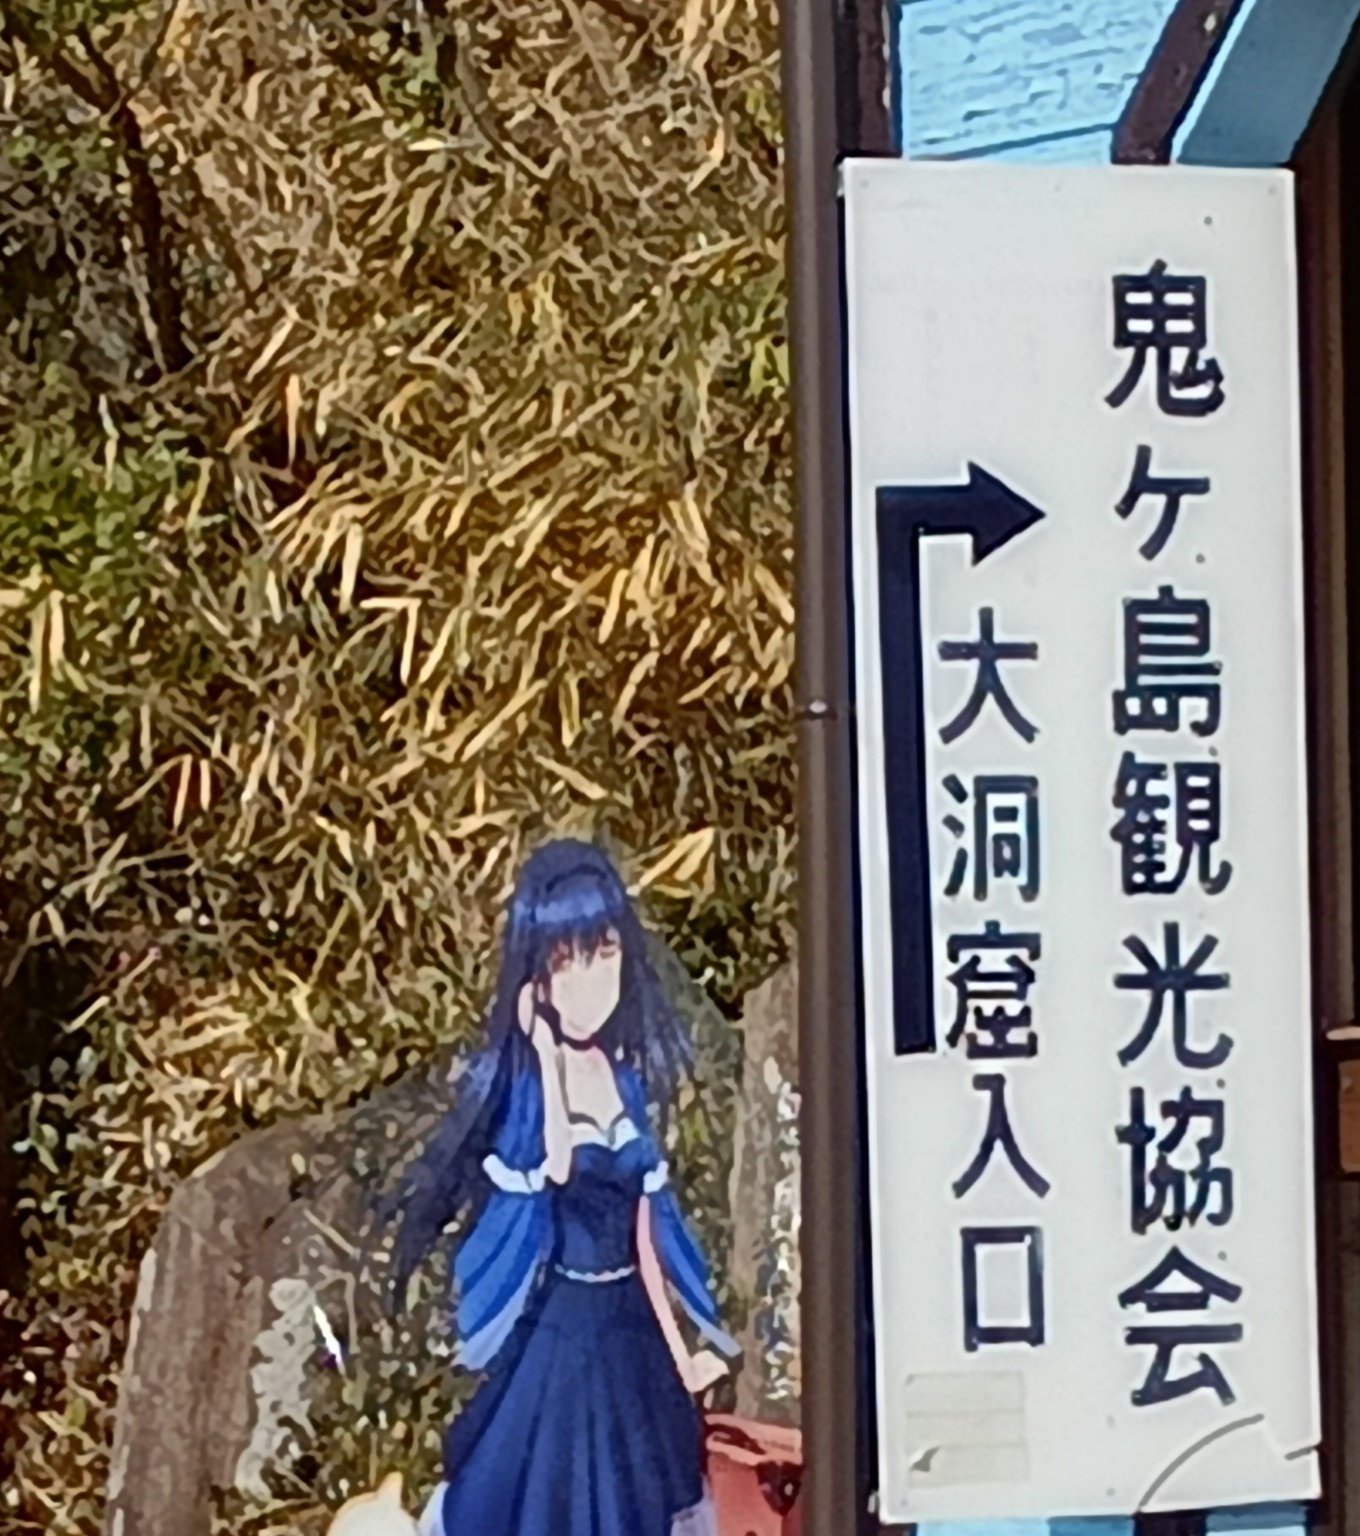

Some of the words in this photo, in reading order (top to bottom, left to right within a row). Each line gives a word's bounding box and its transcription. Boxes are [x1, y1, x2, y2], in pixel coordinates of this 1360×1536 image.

[937, 606, 1051, 1353] 大洞窟入口
